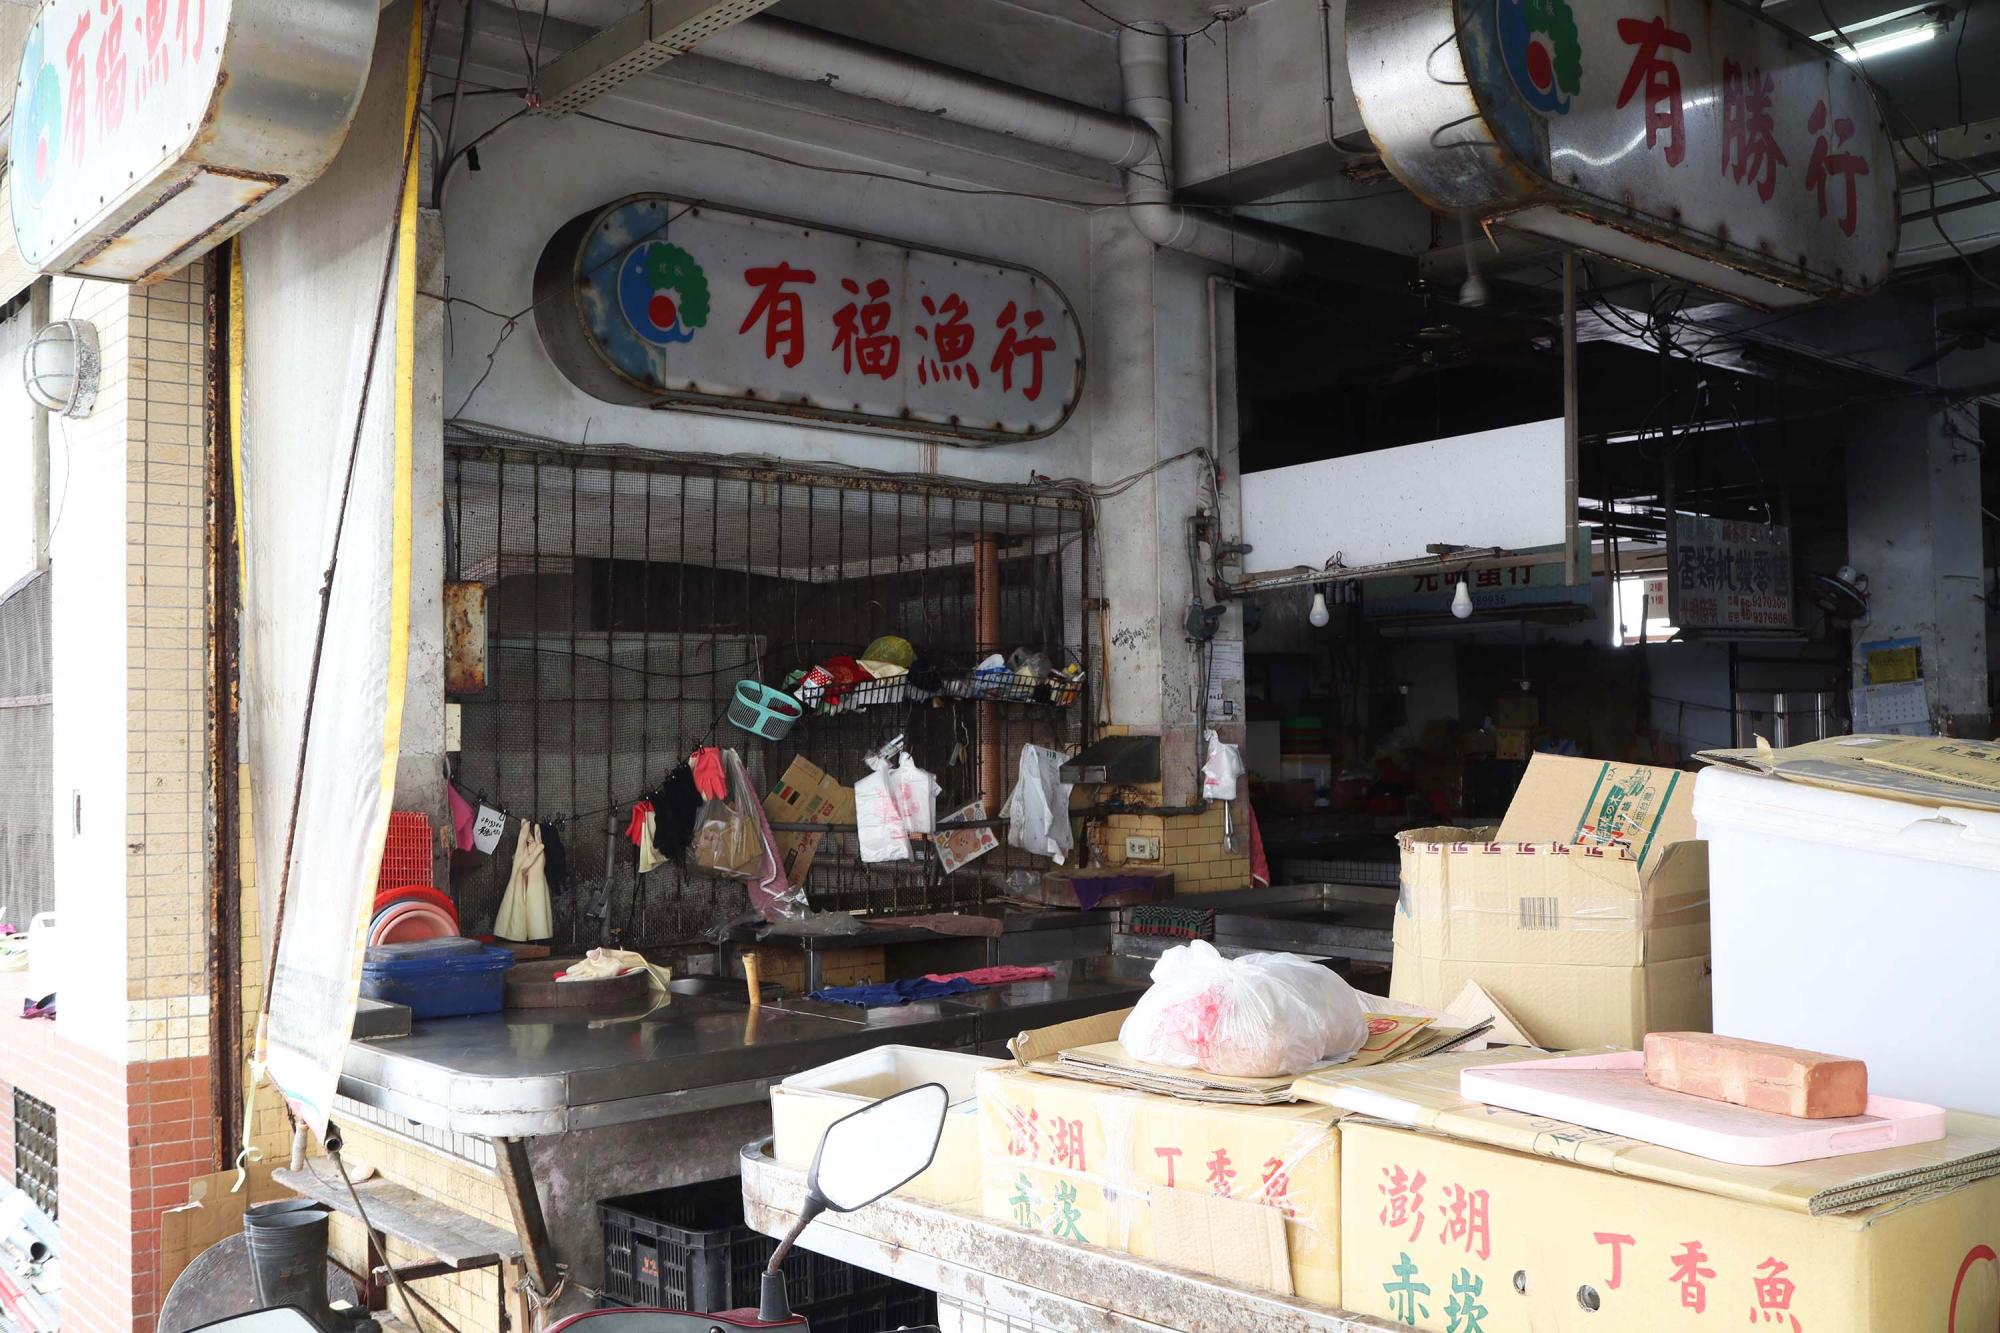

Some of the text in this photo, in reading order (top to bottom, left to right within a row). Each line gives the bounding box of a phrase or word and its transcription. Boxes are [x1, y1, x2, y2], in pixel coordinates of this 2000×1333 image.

[1615, 15, 1870, 238] 有勝行
[738, 260, 1057, 402] 有福漁行
[1007, 1107, 1087, 1173] 澎湖
[1378, 1164, 1804, 1333] 澎湖 丁香魚
[1382, 1251, 1489, 1333] 赤崁
